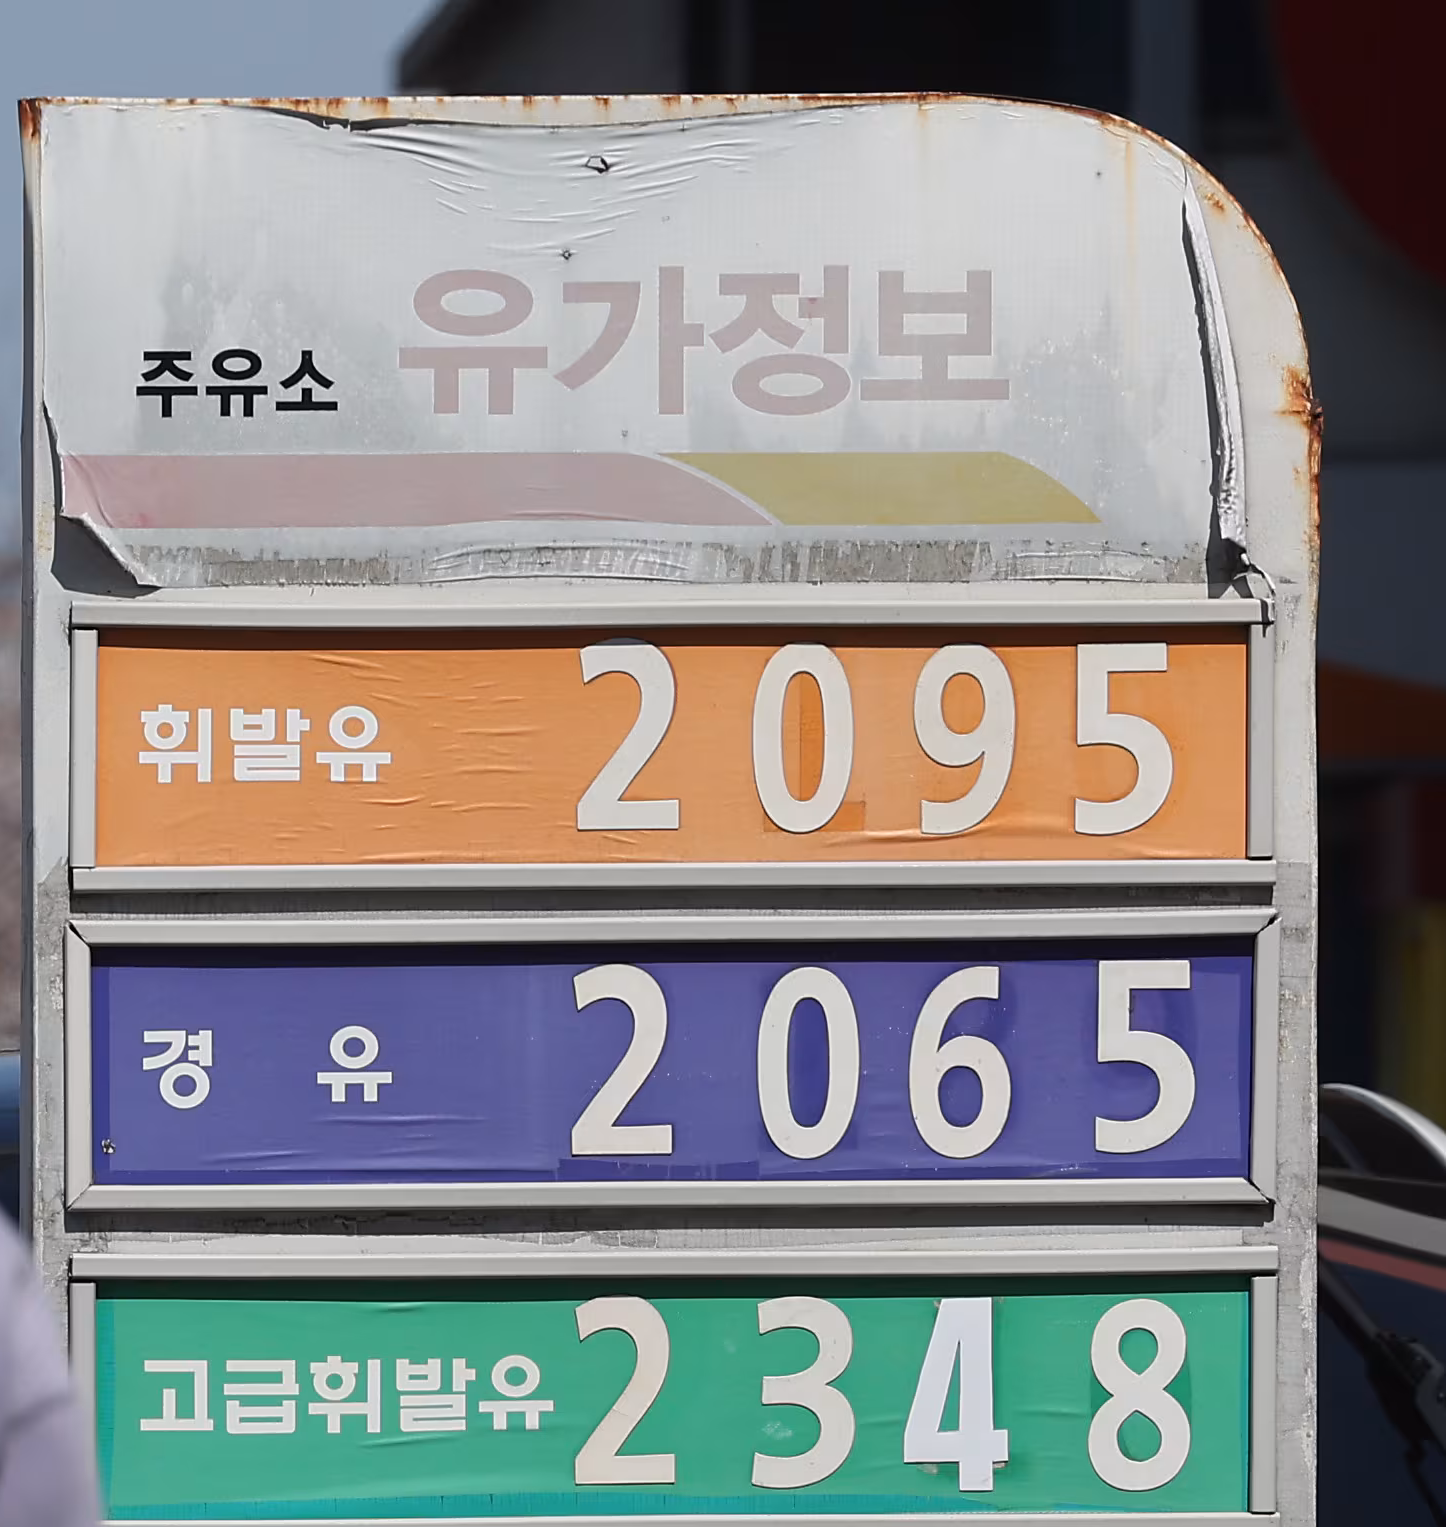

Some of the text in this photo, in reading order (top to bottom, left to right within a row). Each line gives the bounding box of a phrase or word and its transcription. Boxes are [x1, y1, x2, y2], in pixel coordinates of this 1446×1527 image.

[136, 264, 1010, 418] 주유소 유가정보
[138, 638, 1174, 836] 휘발유 2095
[571, 959, 1196, 1159] 2065
[139, 1295, 1191, 1491] 고급휘발유 2348
